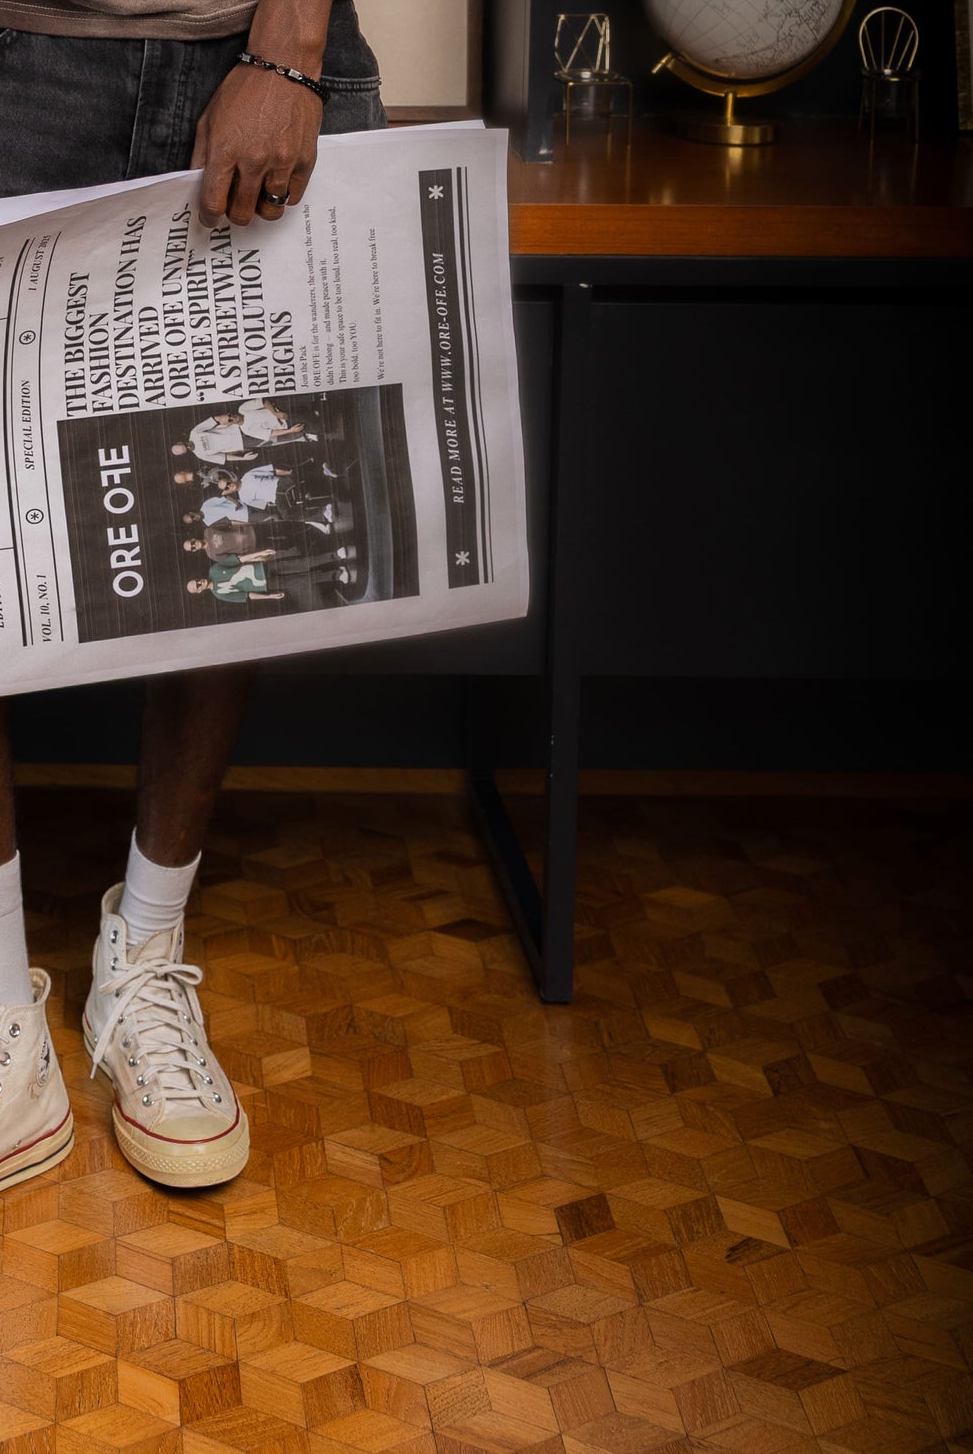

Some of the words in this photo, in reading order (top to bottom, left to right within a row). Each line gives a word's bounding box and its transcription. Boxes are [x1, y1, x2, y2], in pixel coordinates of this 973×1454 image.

[120, 215, 147, 256] HAS
[305, 236, 313, 246] the
[161, 202, 192, 298] UNVEILS-
[332, 253, 340, 265] too
[369, 243, 377, 261] break
[30, 250, 45, 285] AUGUST
[319, 266, 327, 281] with
[371, 262, 378, 270] to
[307, 276, 315, 286] the
[371, 270, 379, 285] here
[321, 282, 330, 300] peace
[334, 296, 342, 304] be
[210, 224, 242, 379] STREETWEAR
[322, 301, 330, 319] made
[64, 272, 90, 365] BIGGEST
[162, 301, 187, 346] OFE
[238, 248, 270, 396] REVOLUTION
[323, 320, 331, 333] and
[337, 314, 346, 331] space
[374, 316, 382, 324] fit
[432, 251, 454, 394] WWW.ORE-OFE.COM
[113, 258, 140, 410] DESTINATION
[311, 335, 319, 345] for
[337, 333, 345, 345] safe
[376, 333, 384, 348] here
[138, 306, 166, 407] ARRIVED
[269, 310, 296, 392] BEGINS
[299, 346, 307, 361] Pack
[325, 343, 334, 364] belong
[339, 346, 347, 362] your
[88, 312, 114, 413] FASHION
[312, 353, 320, 369] OFE
[167, 350, 192, 400] ORE
[313, 370, 321, 387] ORE
[339, 369, 347, 384] This
[64, 368, 88, 417] THE
[222, 381, 243, 398] A
[20, 380, 31, 423] EDITION
[444, 397, 454, 416] AT
[22, 427, 35, 470] SPECIAL
[448, 420, 459, 462] MORE
[452, 466, 465, 504] READ
[107, 524, 144, 598] ORE
[38, 580, 49, 599] NO.
[42, 618, 52, 643] VOL.
